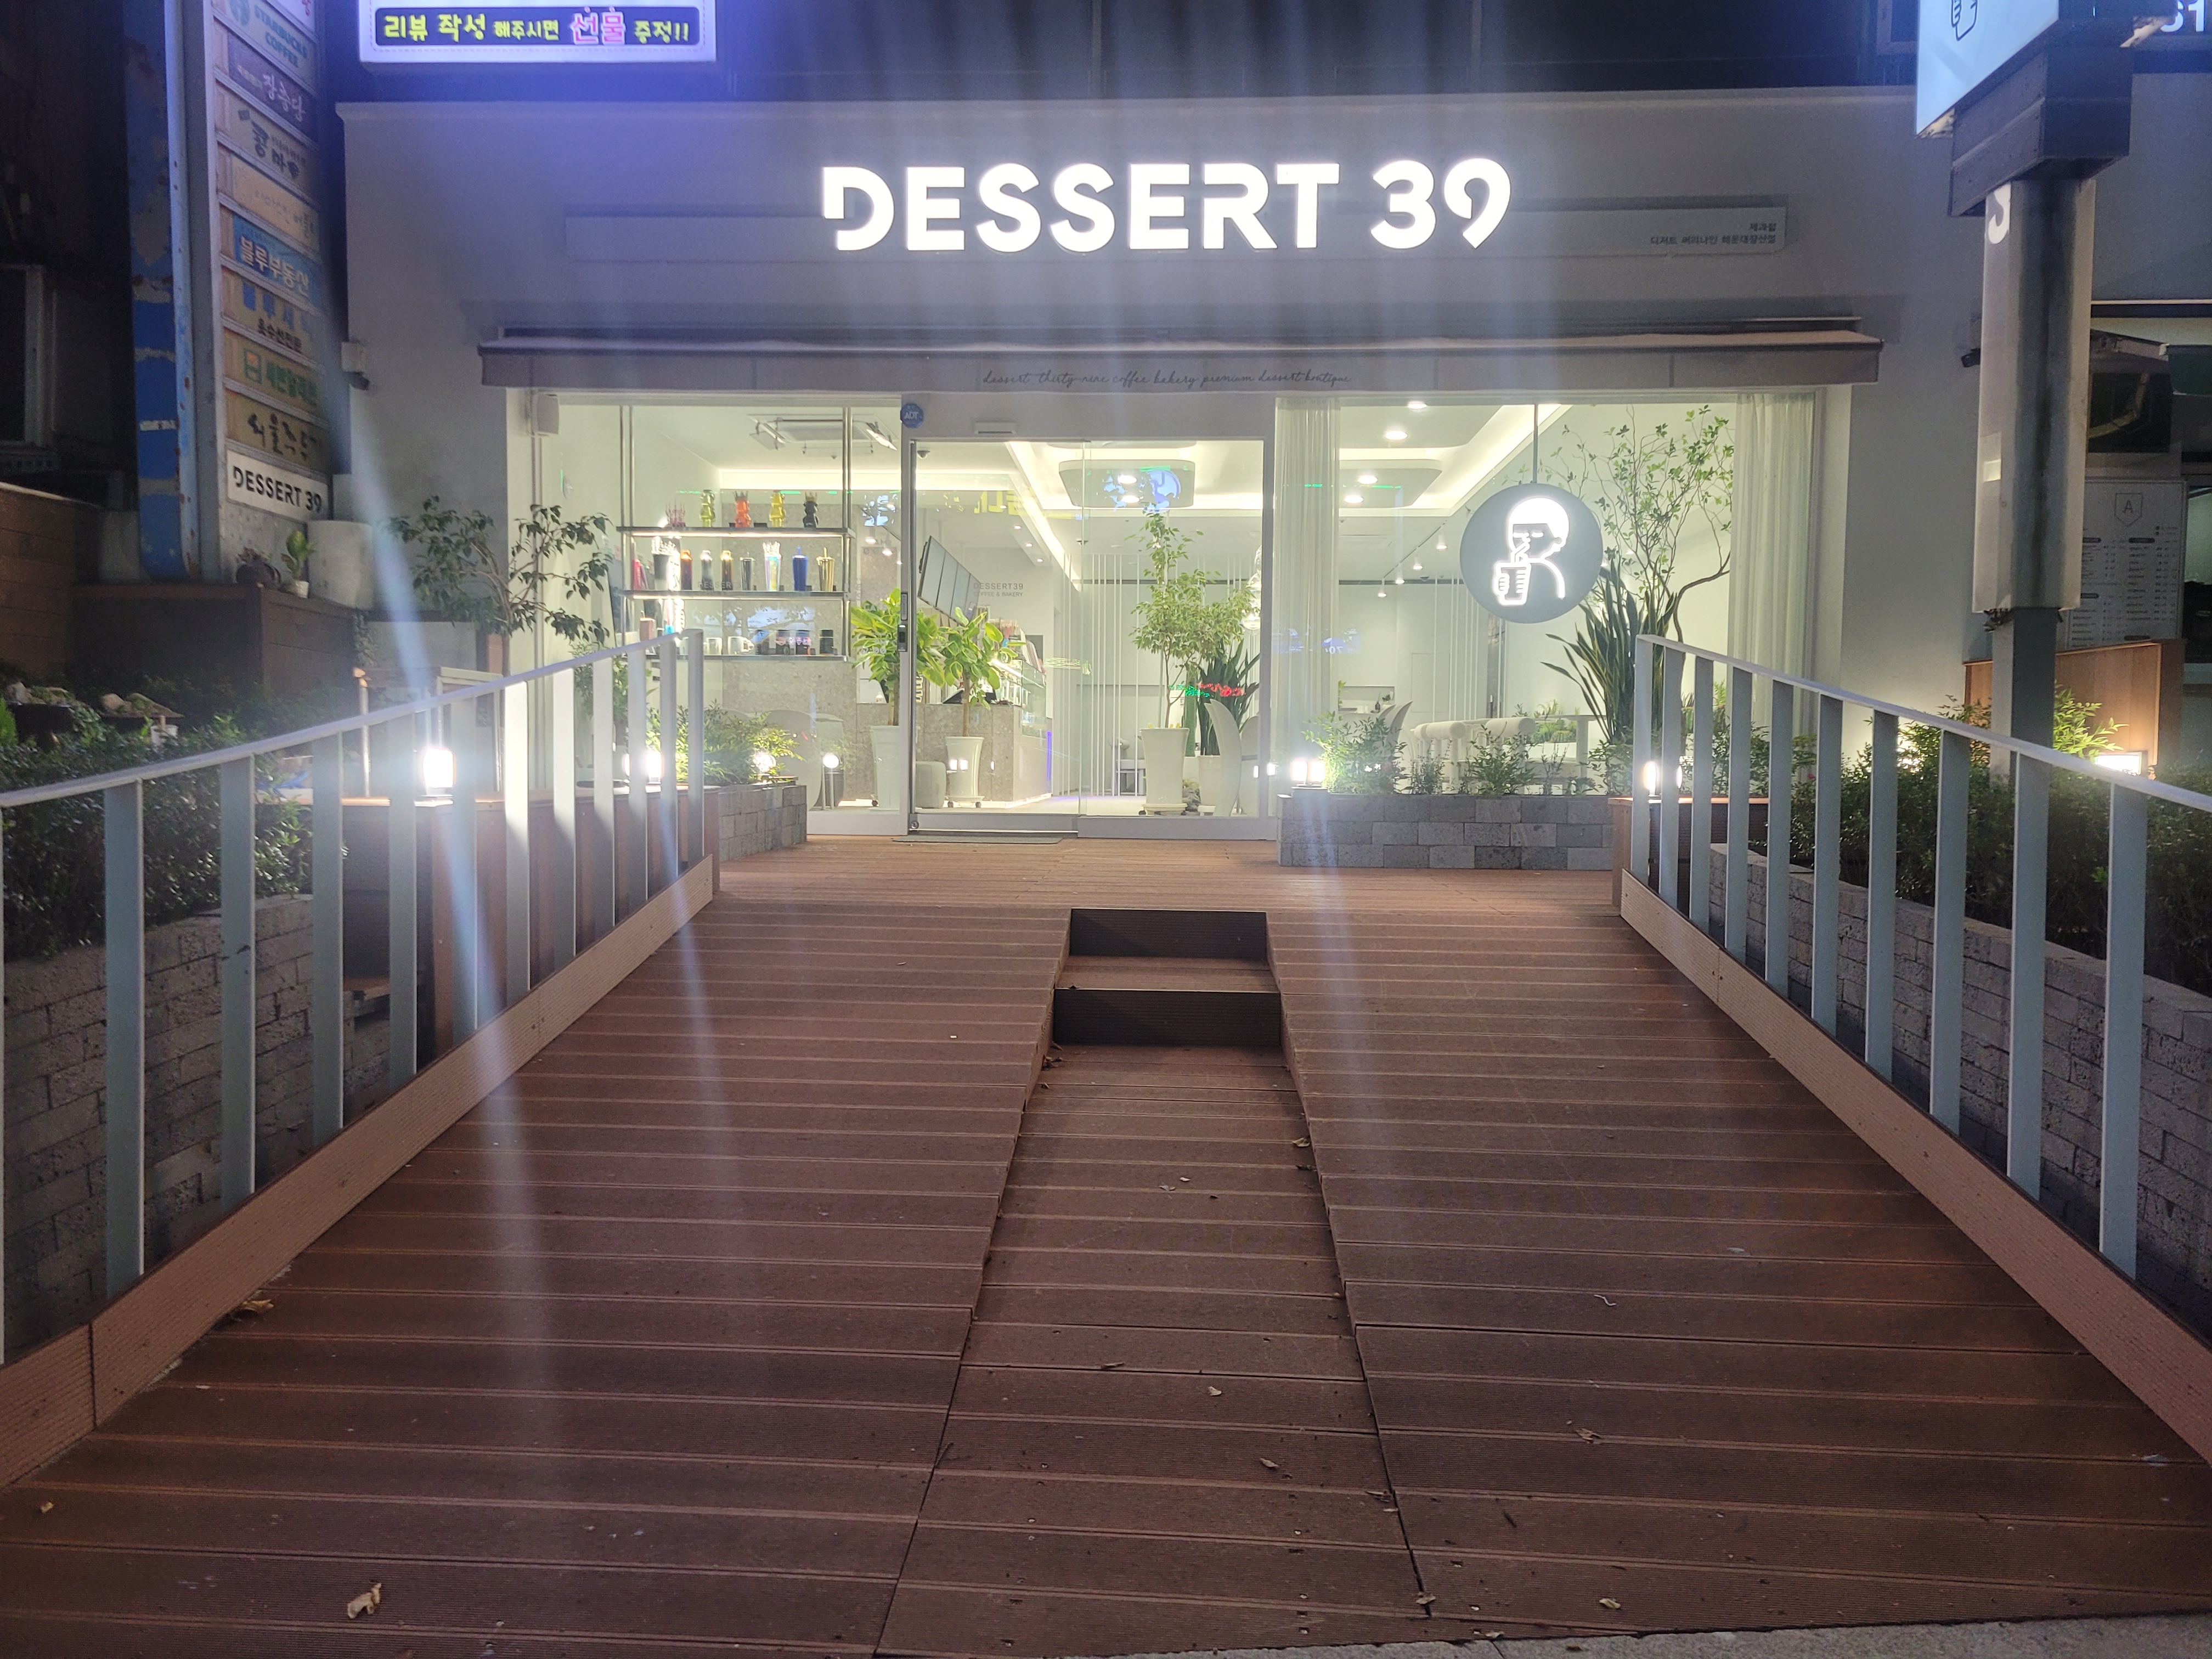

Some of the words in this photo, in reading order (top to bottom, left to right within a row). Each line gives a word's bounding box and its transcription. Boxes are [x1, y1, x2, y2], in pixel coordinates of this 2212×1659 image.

[384, 14, 428, 41] 리뷰
[438, 14, 486, 42] 작성
[494, 20, 559, 41] 해주시면
[571, 9, 625, 44] 선물
[823, 162, 1340, 252] DESSERT
[1370, 159, 1512, 250] 39
[241, 234, 309, 299] 블루부동산
[1112, 370, 1150, 388] coffee
[1153, 369, 1199, 390] bakery
[904, 411, 919, 420] ADT
[233, 466, 301, 507] DESSERT
[305, 490, 323, 513] 39
[2123, 500, 2134, 514] A
